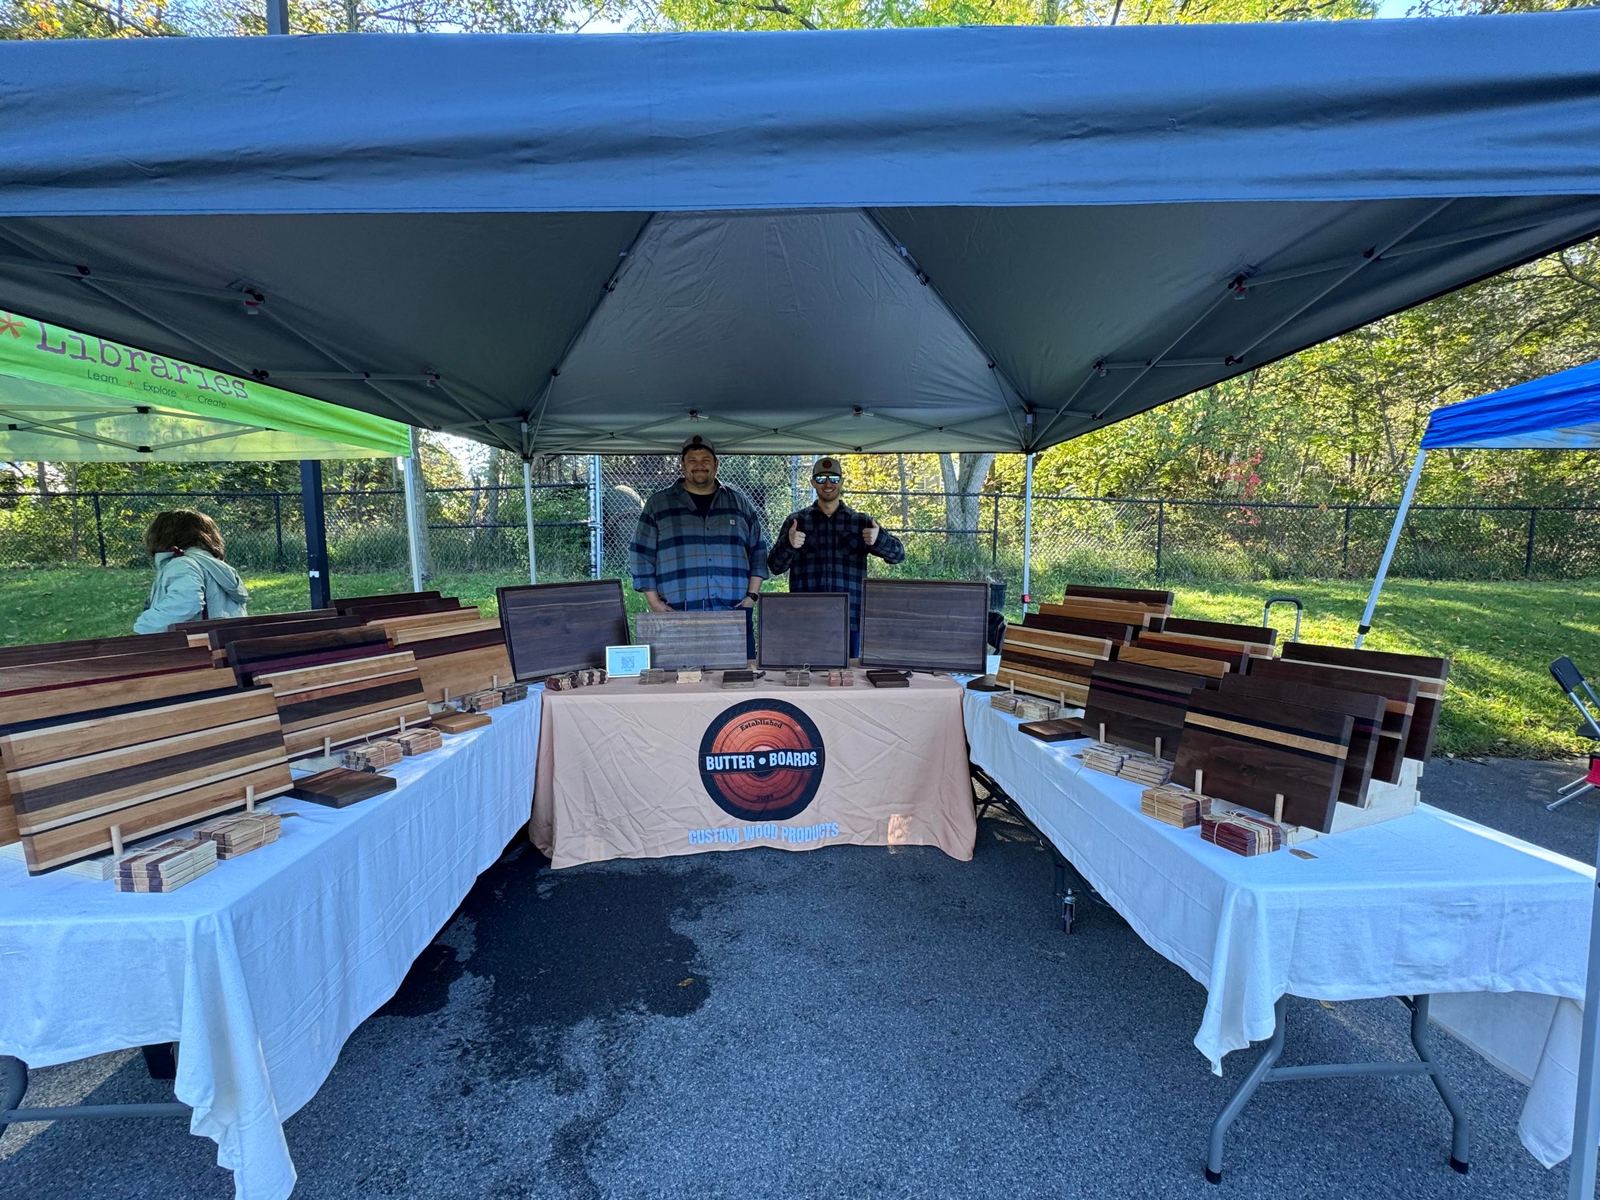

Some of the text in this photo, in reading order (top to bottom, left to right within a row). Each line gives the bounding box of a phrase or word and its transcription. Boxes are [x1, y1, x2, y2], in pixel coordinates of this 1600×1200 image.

[36, 321, 249, 399] Libraries
[87, 369, 227, 409] Learn Explore Create
[740, 719, 783, 731] Established
[706, 751, 817, 770] BUTTER BOARDS
[688, 822, 839, 845] CUSTOM WOOD PRODUCTS
